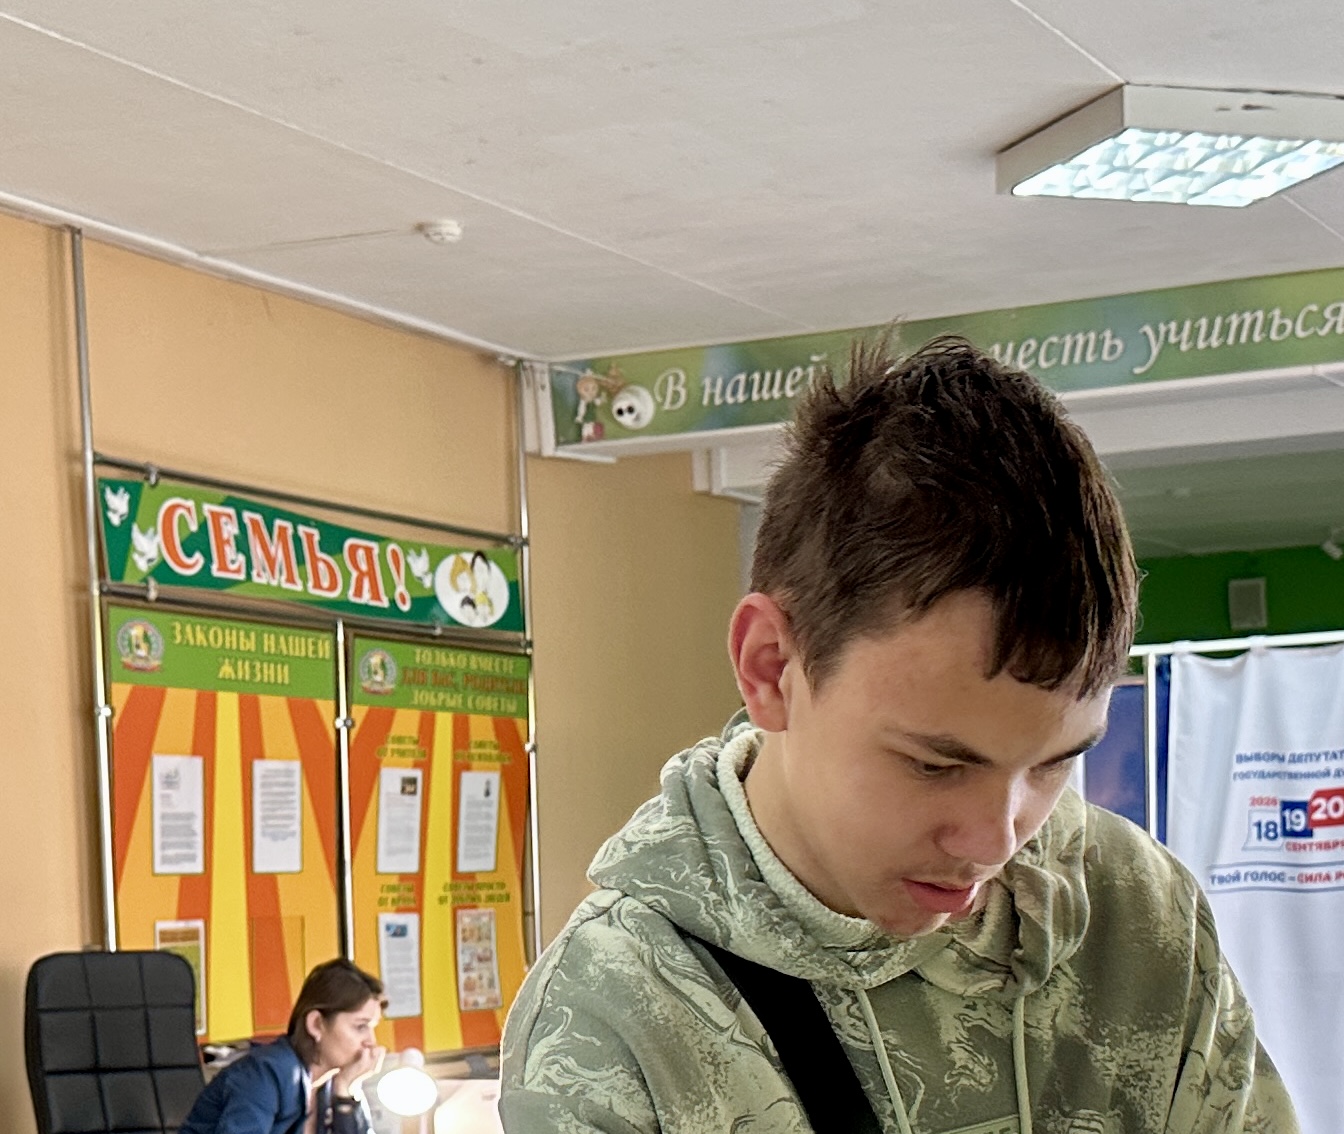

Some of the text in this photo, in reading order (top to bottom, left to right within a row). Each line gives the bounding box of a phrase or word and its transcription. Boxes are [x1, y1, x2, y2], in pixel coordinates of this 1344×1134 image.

[654, 368, 688, 411] В
[156, 496, 412, 613] СЕМЬЯ!
[171, 620, 331, 660] ЗАКОНЫ НАШЕЙ
[217, 657, 290, 685] ЖИЗНИ
[1235, 751, 1285, 765] ВЫБОРЫ
[1252, 796, 1344, 841] 18 19 20
[1210, 870, 1241, 885] ТВОЙ
[1244, 871, 1286, 883] ГОЛОС
[1297, 871, 1331, 884] СИЛА
